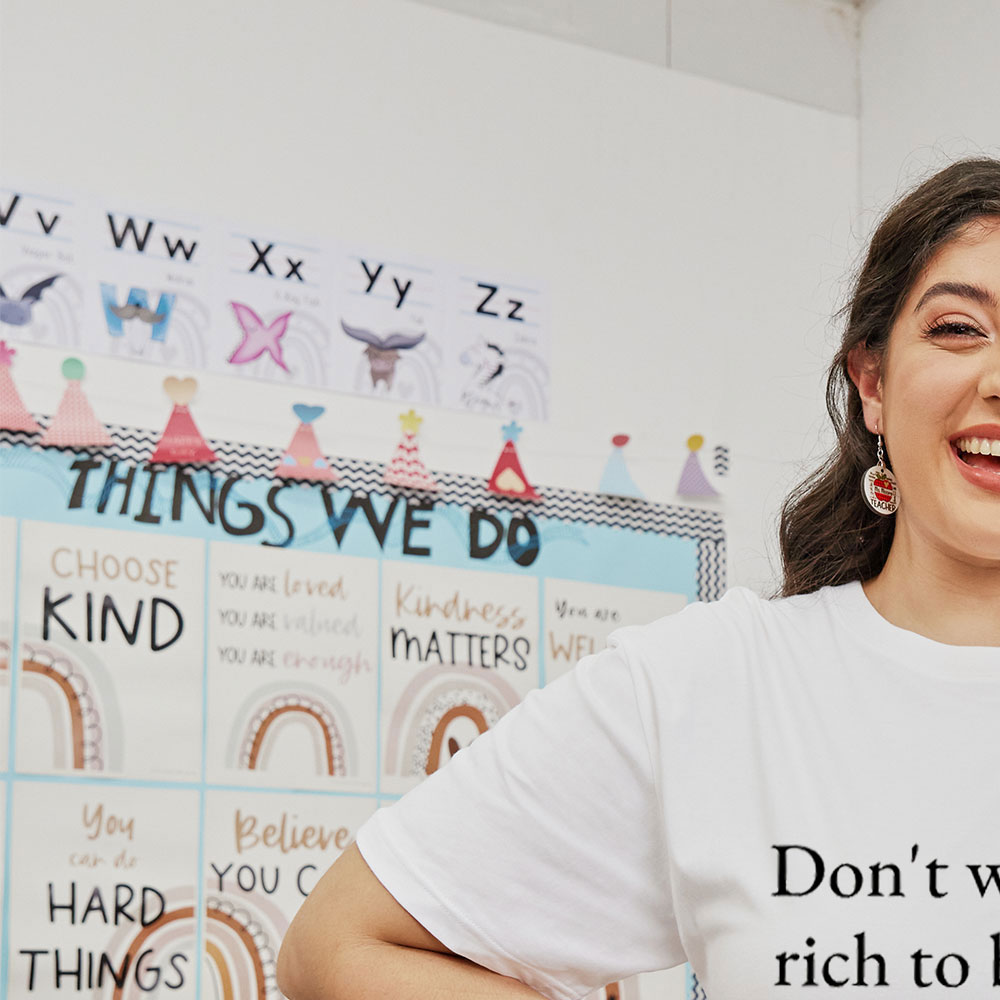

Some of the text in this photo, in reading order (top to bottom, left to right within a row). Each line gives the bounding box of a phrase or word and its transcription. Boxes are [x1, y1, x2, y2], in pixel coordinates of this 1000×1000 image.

[67, 457, 541, 568] THINGS WE DO
[51, 547, 180, 590] CHOOSE
[219, 568, 347, 600] YOU ARE loved
[43, 586, 185, 652] KIND
[218, 608, 248, 627] YOU
[252, 611, 276, 630] ARE
[395, 581, 527, 630] Kindness
[217, 645, 248, 664] YOU
[251, 648, 275, 667] ARE
[83, 803, 135, 842] You
[235, 808, 354, 855] Believe
[69, 851, 107, 869] can
[210, 862, 281, 894] YOU
[771, 843, 949, 899] Don't
[48, 881, 166, 928] HARD
[19, 948, 189, 993] THINGS
[775, 931, 890, 988] rich
[911, 948, 970, 988] to
